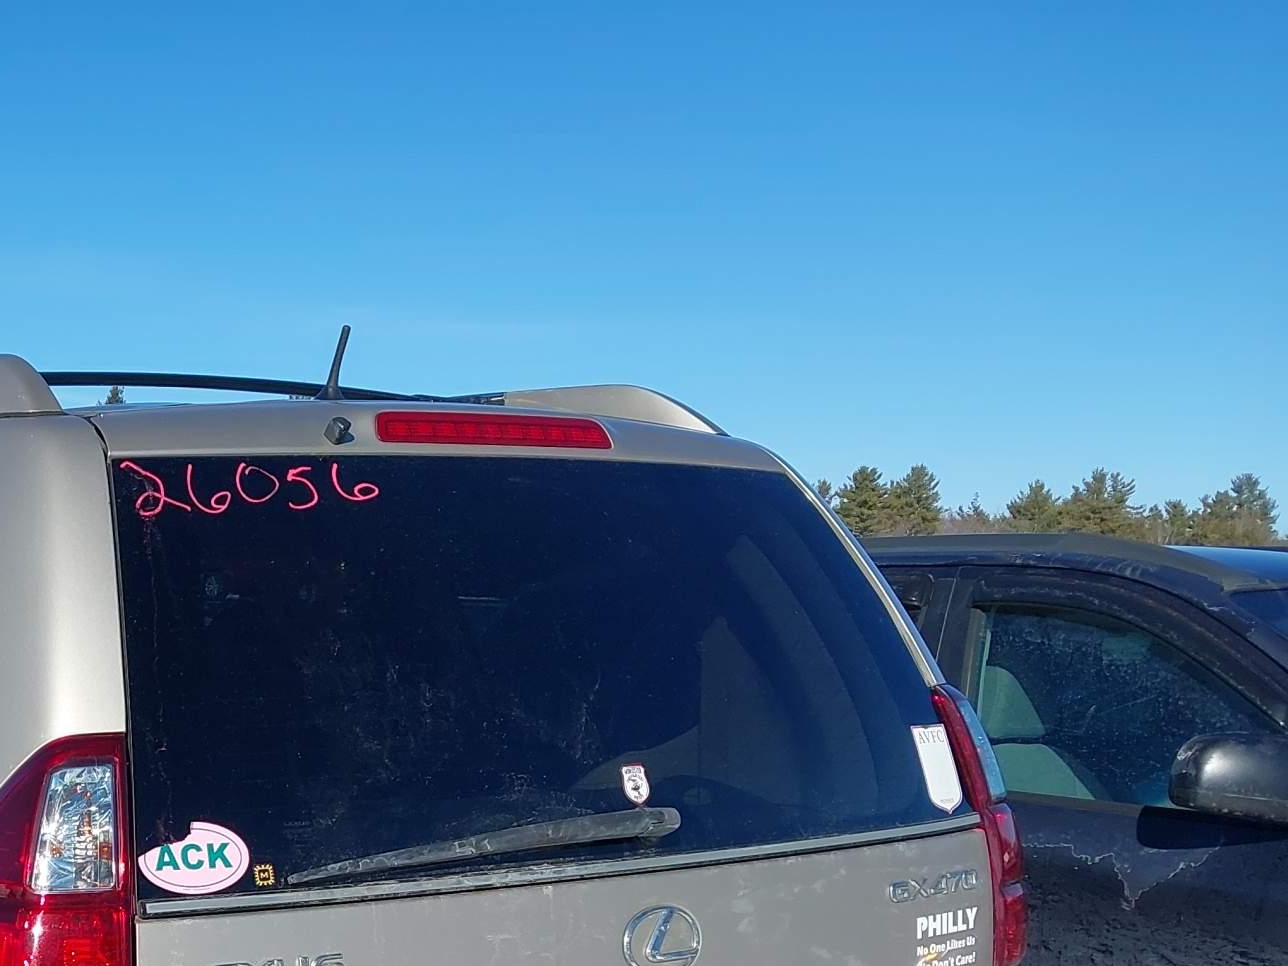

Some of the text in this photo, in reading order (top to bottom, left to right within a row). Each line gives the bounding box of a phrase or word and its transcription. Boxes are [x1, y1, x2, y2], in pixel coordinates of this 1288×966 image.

[119, 460, 380, 518] 26056
[918, 729, 945, 745] AVFC
[154, 841, 234, 872] ACK
[915, 906, 978, 940] PHILLY
[916, 944, 929, 957] No
[929, 943, 946, 954] One
[966, 935, 976, 946] Us
[955, 951, 976, 966] Care!
